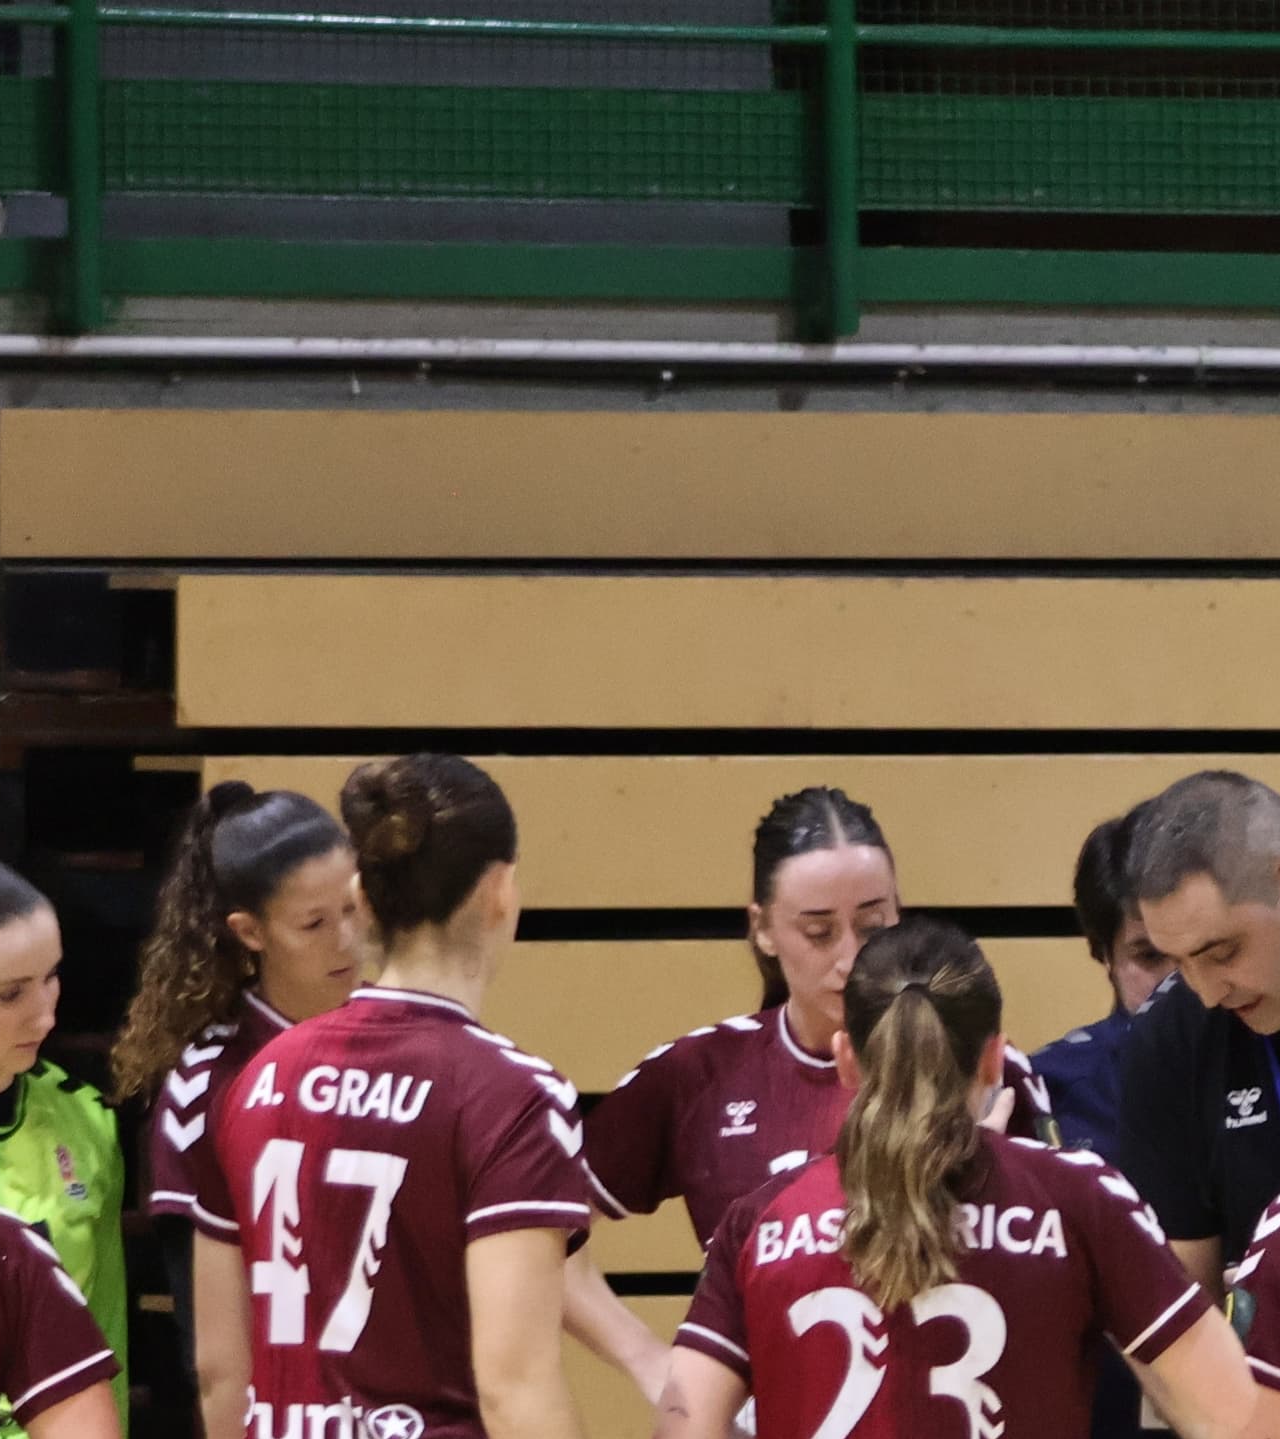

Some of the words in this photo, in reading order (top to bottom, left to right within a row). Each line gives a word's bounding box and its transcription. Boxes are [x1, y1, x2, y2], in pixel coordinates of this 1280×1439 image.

[246, 1062, 286, 1109] A.
[299, 1065, 432, 1123] GRAU
[252, 1138, 408, 1353] 47
